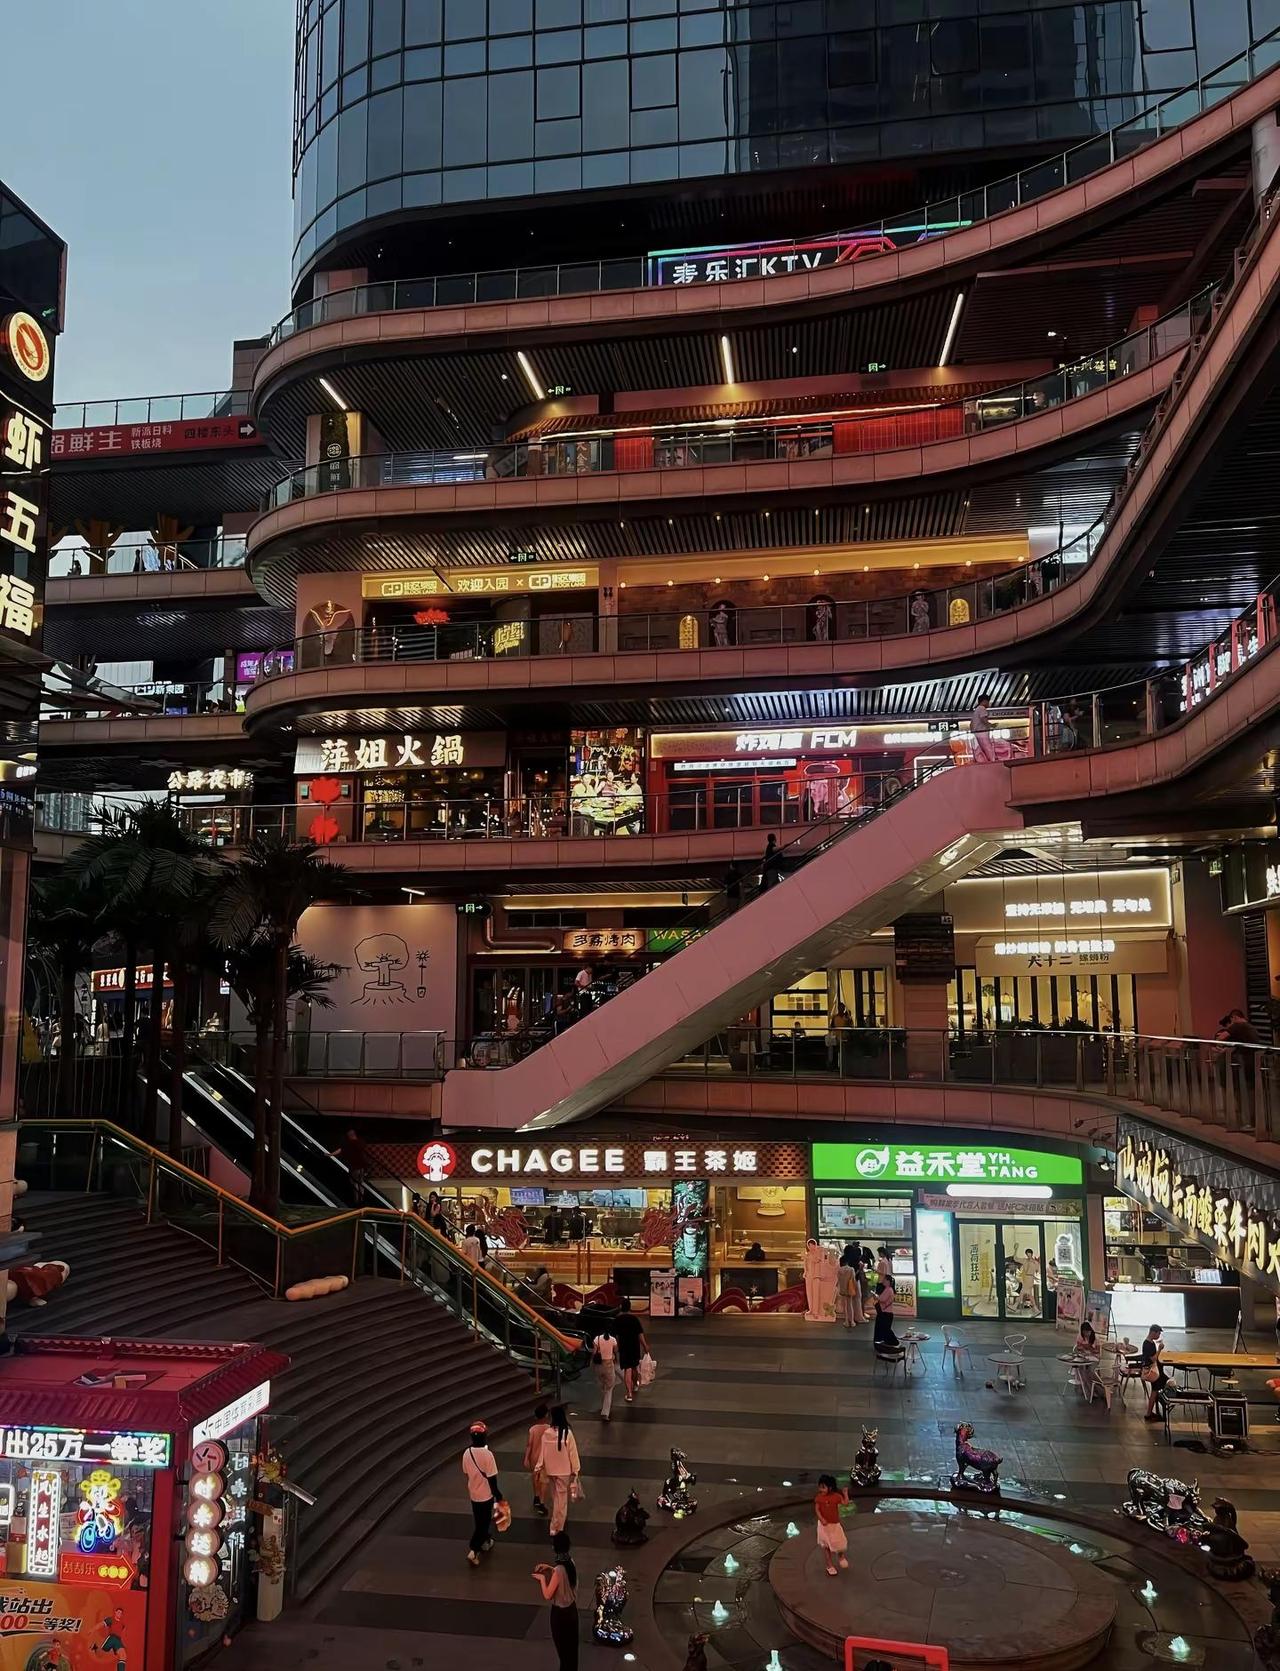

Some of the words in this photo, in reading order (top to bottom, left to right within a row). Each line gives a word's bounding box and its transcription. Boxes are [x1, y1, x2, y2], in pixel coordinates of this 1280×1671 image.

[457, 577, 509, 592] 欢迎入园
[470, 1148, 625, 1173] CHAGEE
[643, 1150, 757, 1172] 霸王茶姬
[894, 1150, 987, 1178] 益禾堂
[987, 1166, 1039, 1178] TANG
[0, 1429, 166, 1465] 出25万一等奖
